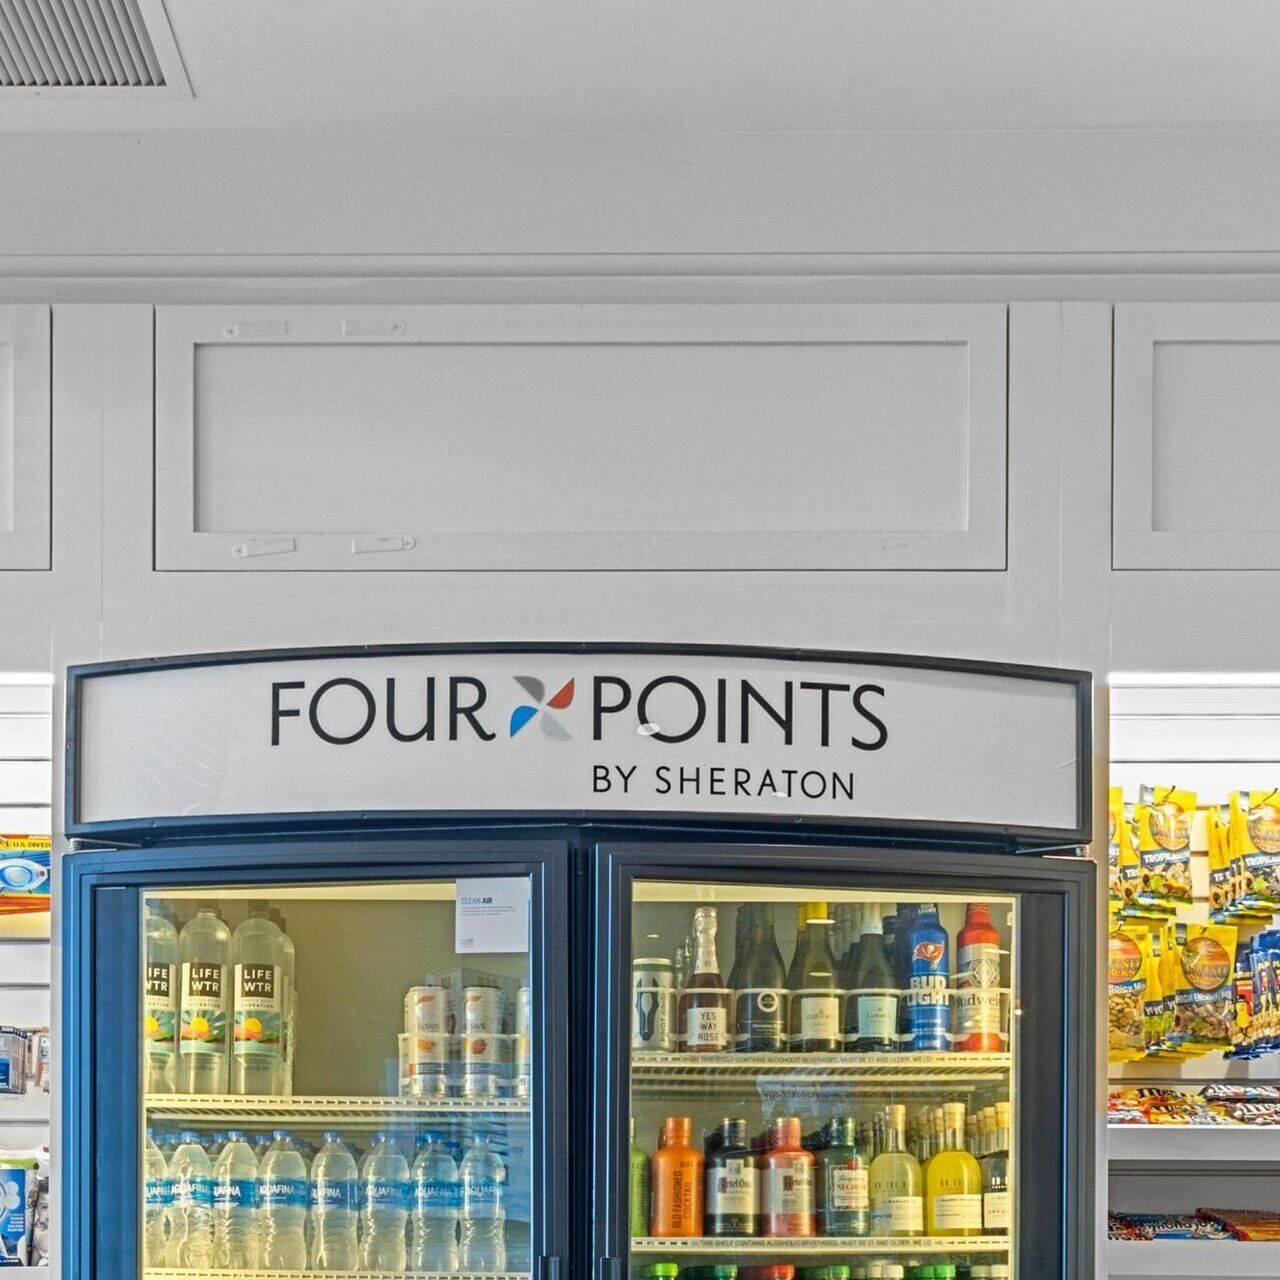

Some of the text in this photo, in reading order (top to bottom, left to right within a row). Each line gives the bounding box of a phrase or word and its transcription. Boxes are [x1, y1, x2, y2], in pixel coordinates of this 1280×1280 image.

[270, 676, 888, 751] FOUR POINTS
[593, 765, 856, 800] BY SHERATON
[461, 897, 493, 905] CLEAN AIR
[148, 968, 168, 979] IFE
[192, 968, 220, 979] LIFE
[244, 969, 272, 980] LIFE
[192, 981, 220, 992] WTR
[244, 982, 272, 993] WTR
[910, 976, 947, 990] BUD
[907, 990, 949, 1006] LIGHT
[700, 1012, 716, 1020] YES
[700, 1022, 718, 1031] WAY
[365, 1186, 404, 1198] AQUAFINA
[672, 1170, 683, 1229] OLD FASHIONED
[684, 1181, 693, 1220] COCKTAIL
